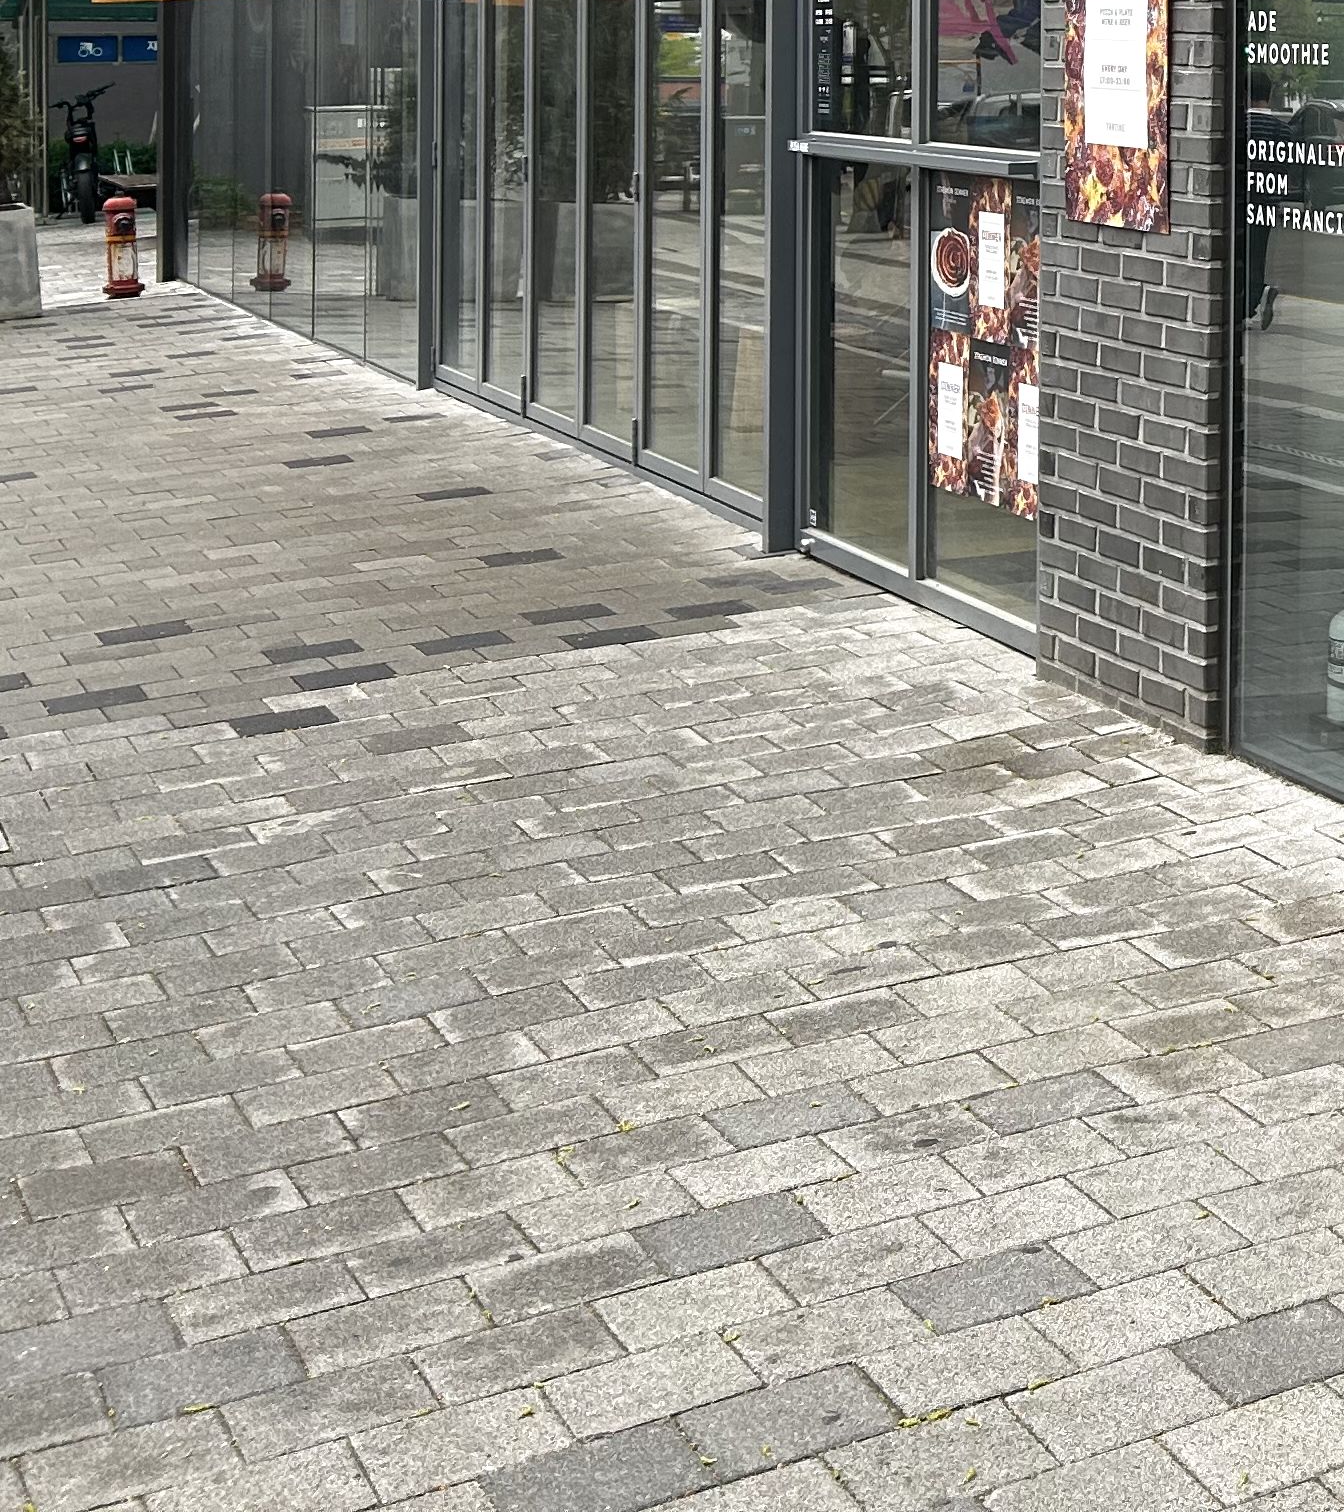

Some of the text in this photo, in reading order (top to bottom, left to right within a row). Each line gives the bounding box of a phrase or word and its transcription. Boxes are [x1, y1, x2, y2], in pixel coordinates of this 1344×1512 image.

[1248, 10, 1277, 32] ADE
[1248, 43, 1329, 66] SMOOTHIE
[1247, 139, 1344, 167] ORIGINALLY
[1247, 171, 1288, 195] FROM
[1246, 203, 1276, 228] SAN
